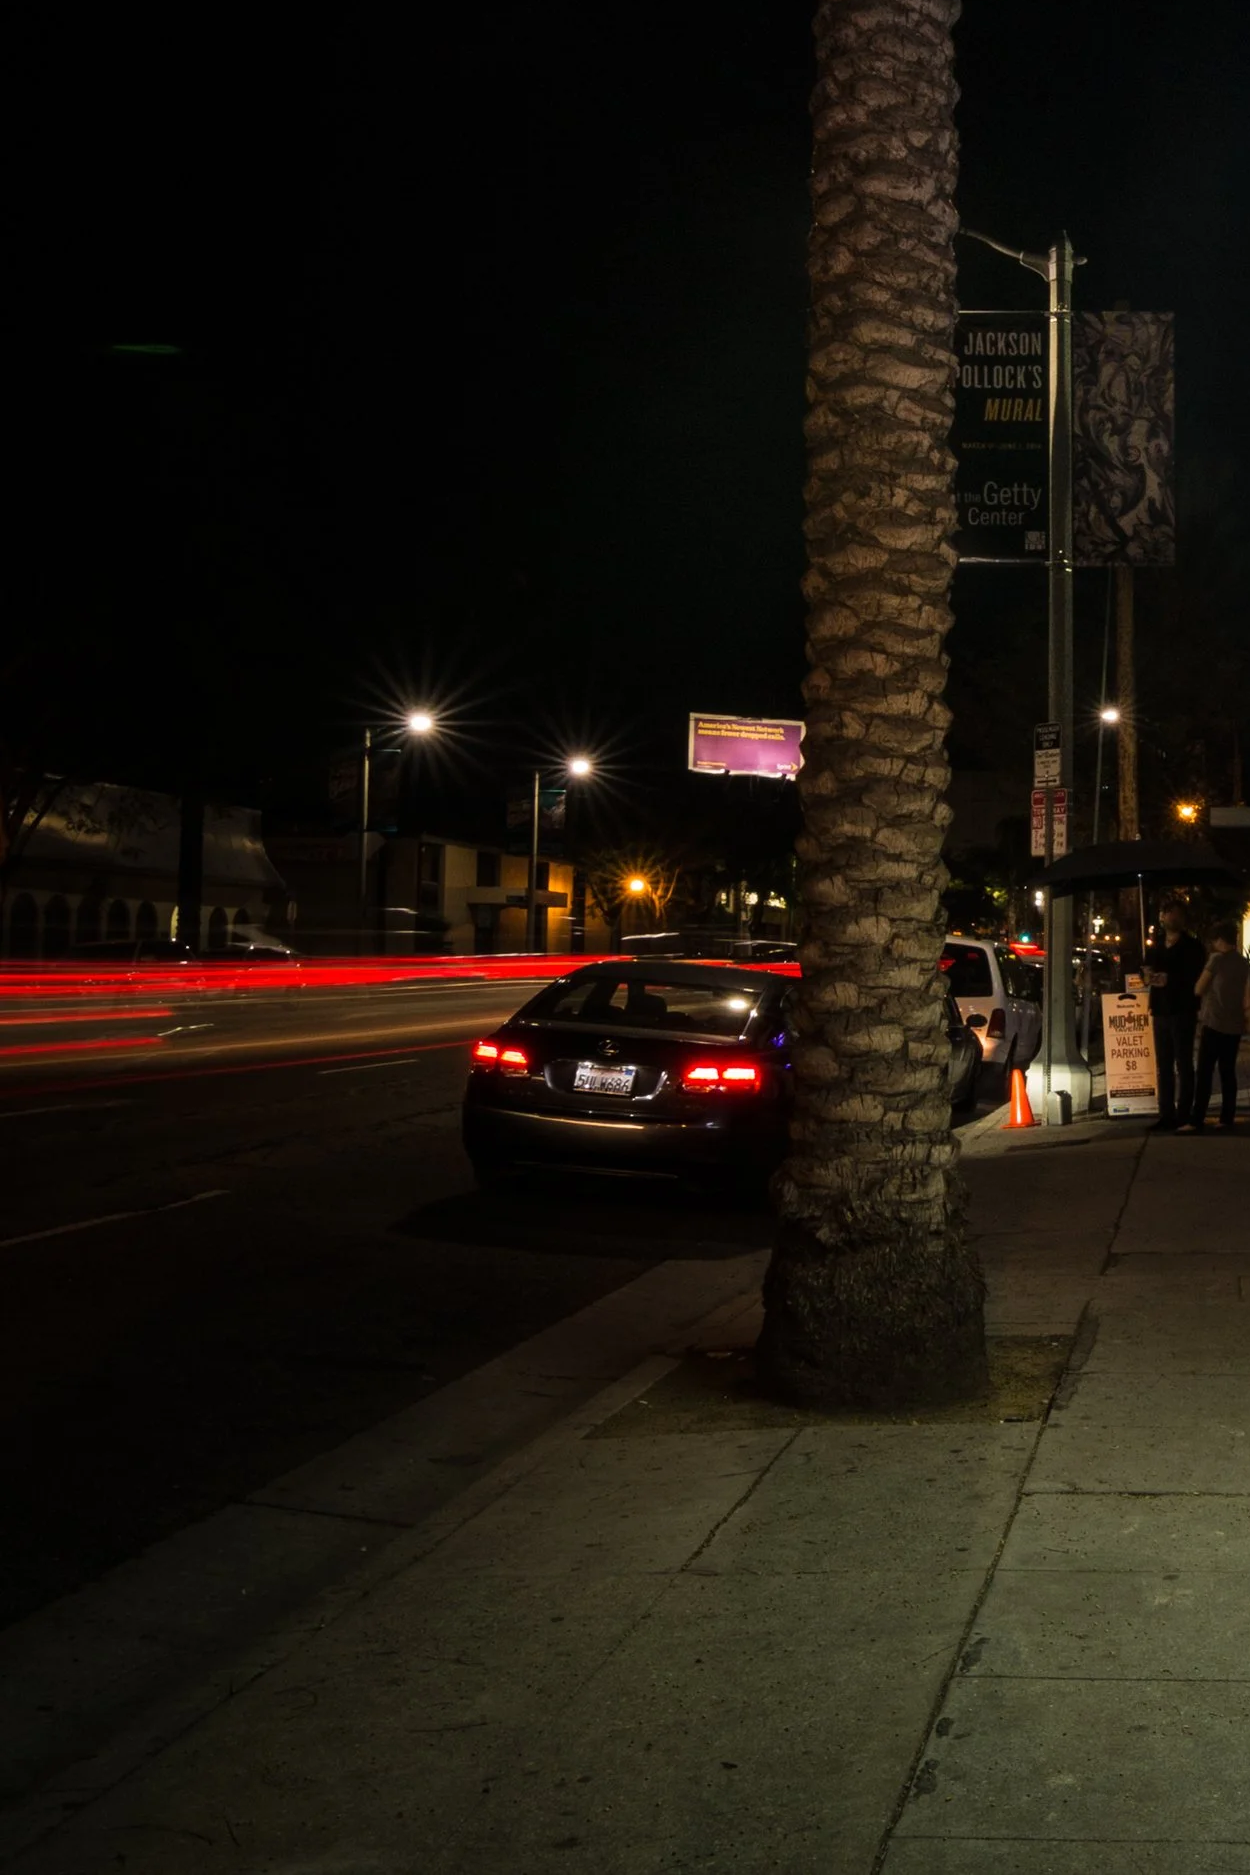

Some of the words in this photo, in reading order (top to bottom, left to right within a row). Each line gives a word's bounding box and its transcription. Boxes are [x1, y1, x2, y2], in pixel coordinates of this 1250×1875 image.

[963, 331, 1043, 357] JACKSON
[983, 397, 1044, 422] MURAL
[963, 491, 982, 503] the
[983, 481, 1043, 511] Getty
[967, 507, 1026, 526] Center
[1108, 1015, 1127, 1030] MUD
[1133, 1014, 1149, 1029] HEN
[1116, 1035, 1144, 1047] VALET
[1111, 1047, 1150, 1060] PARKING
[1125, 1060, 1138, 1072] $8
